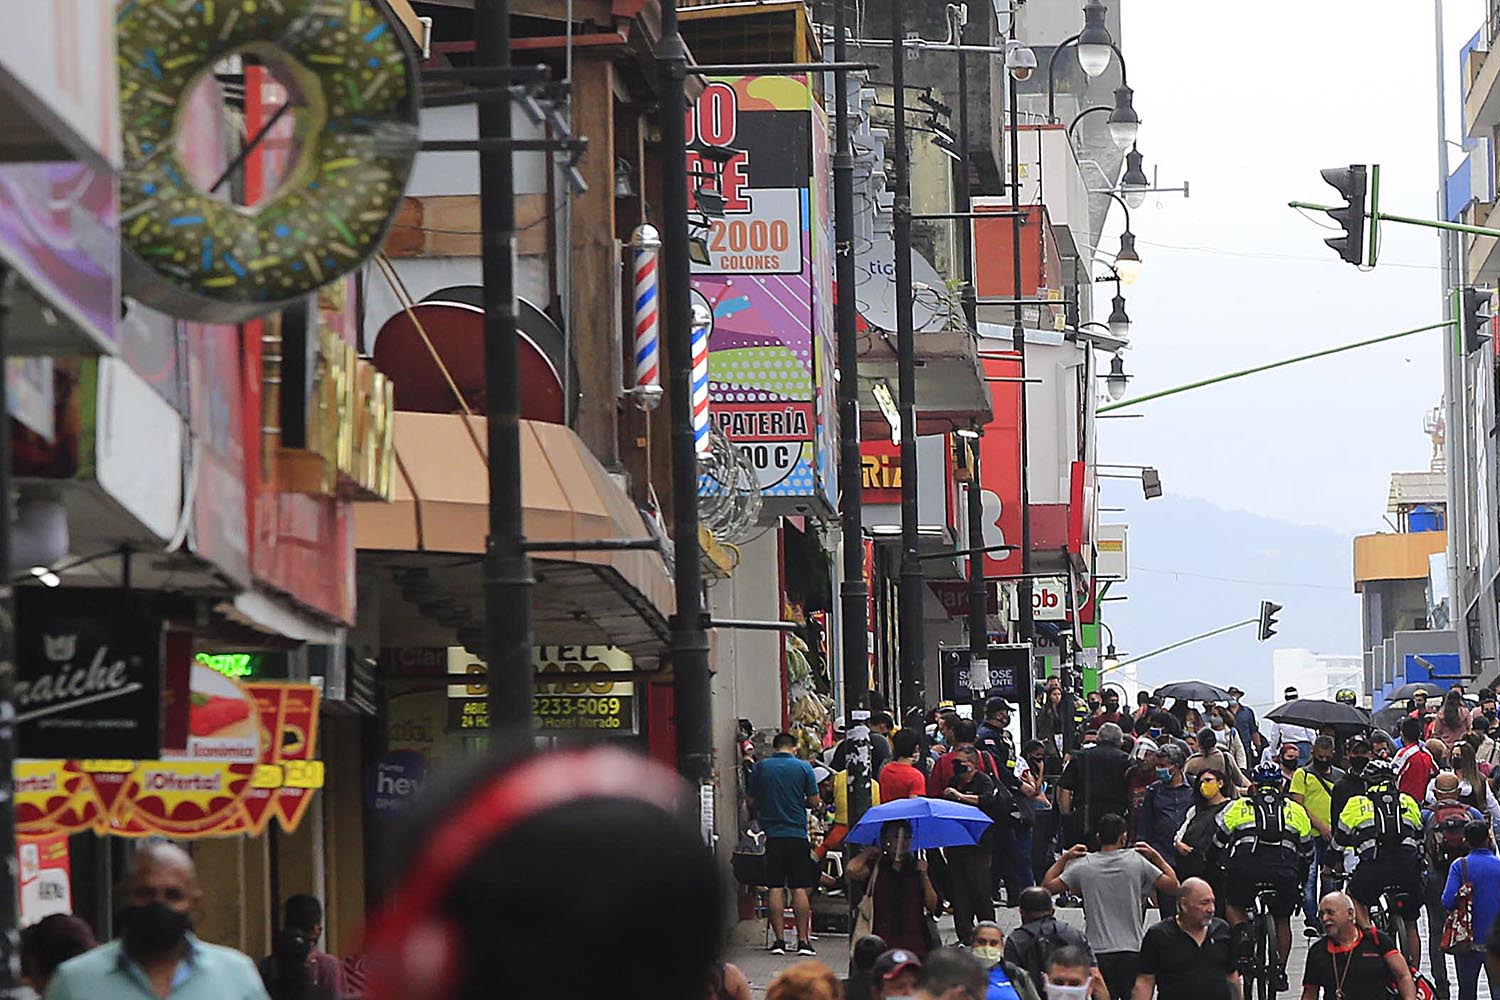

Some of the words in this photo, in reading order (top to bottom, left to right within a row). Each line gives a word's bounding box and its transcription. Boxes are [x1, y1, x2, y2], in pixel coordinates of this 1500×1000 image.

[710, 220, 789, 252] 2000
[720, 255, 780, 270] COLONES
[775, 446, 789, 469] C
